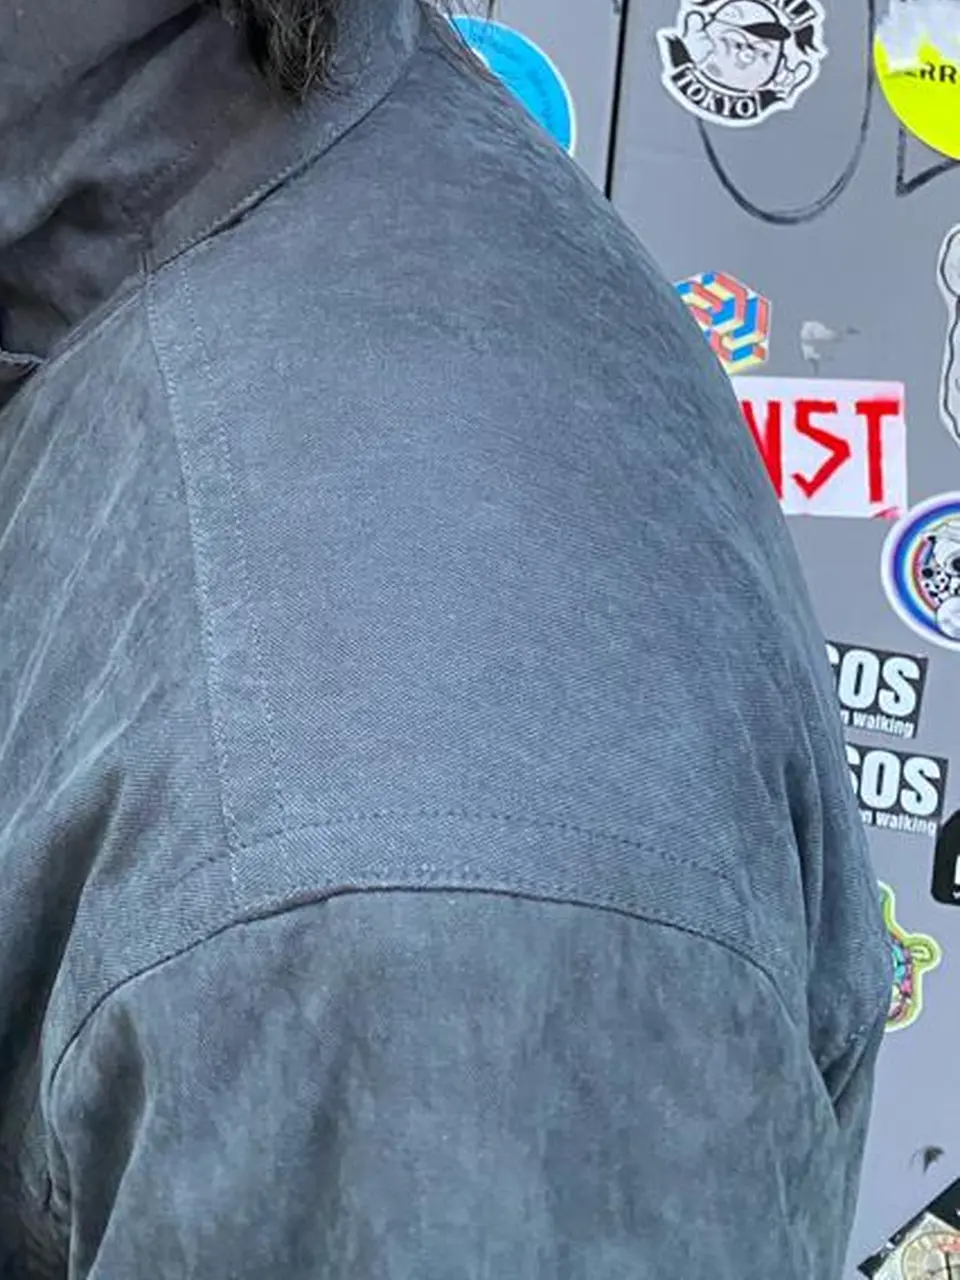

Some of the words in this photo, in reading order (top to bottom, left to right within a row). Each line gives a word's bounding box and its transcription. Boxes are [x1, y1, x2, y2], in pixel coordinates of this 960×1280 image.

[676, 71, 756, 118] TOKYO
[826, 644, 920, 717] OS
[853, 710, 914, 738] walking
[845, 744, 941, 817] OS
[876, 812, 937, 838] walking
